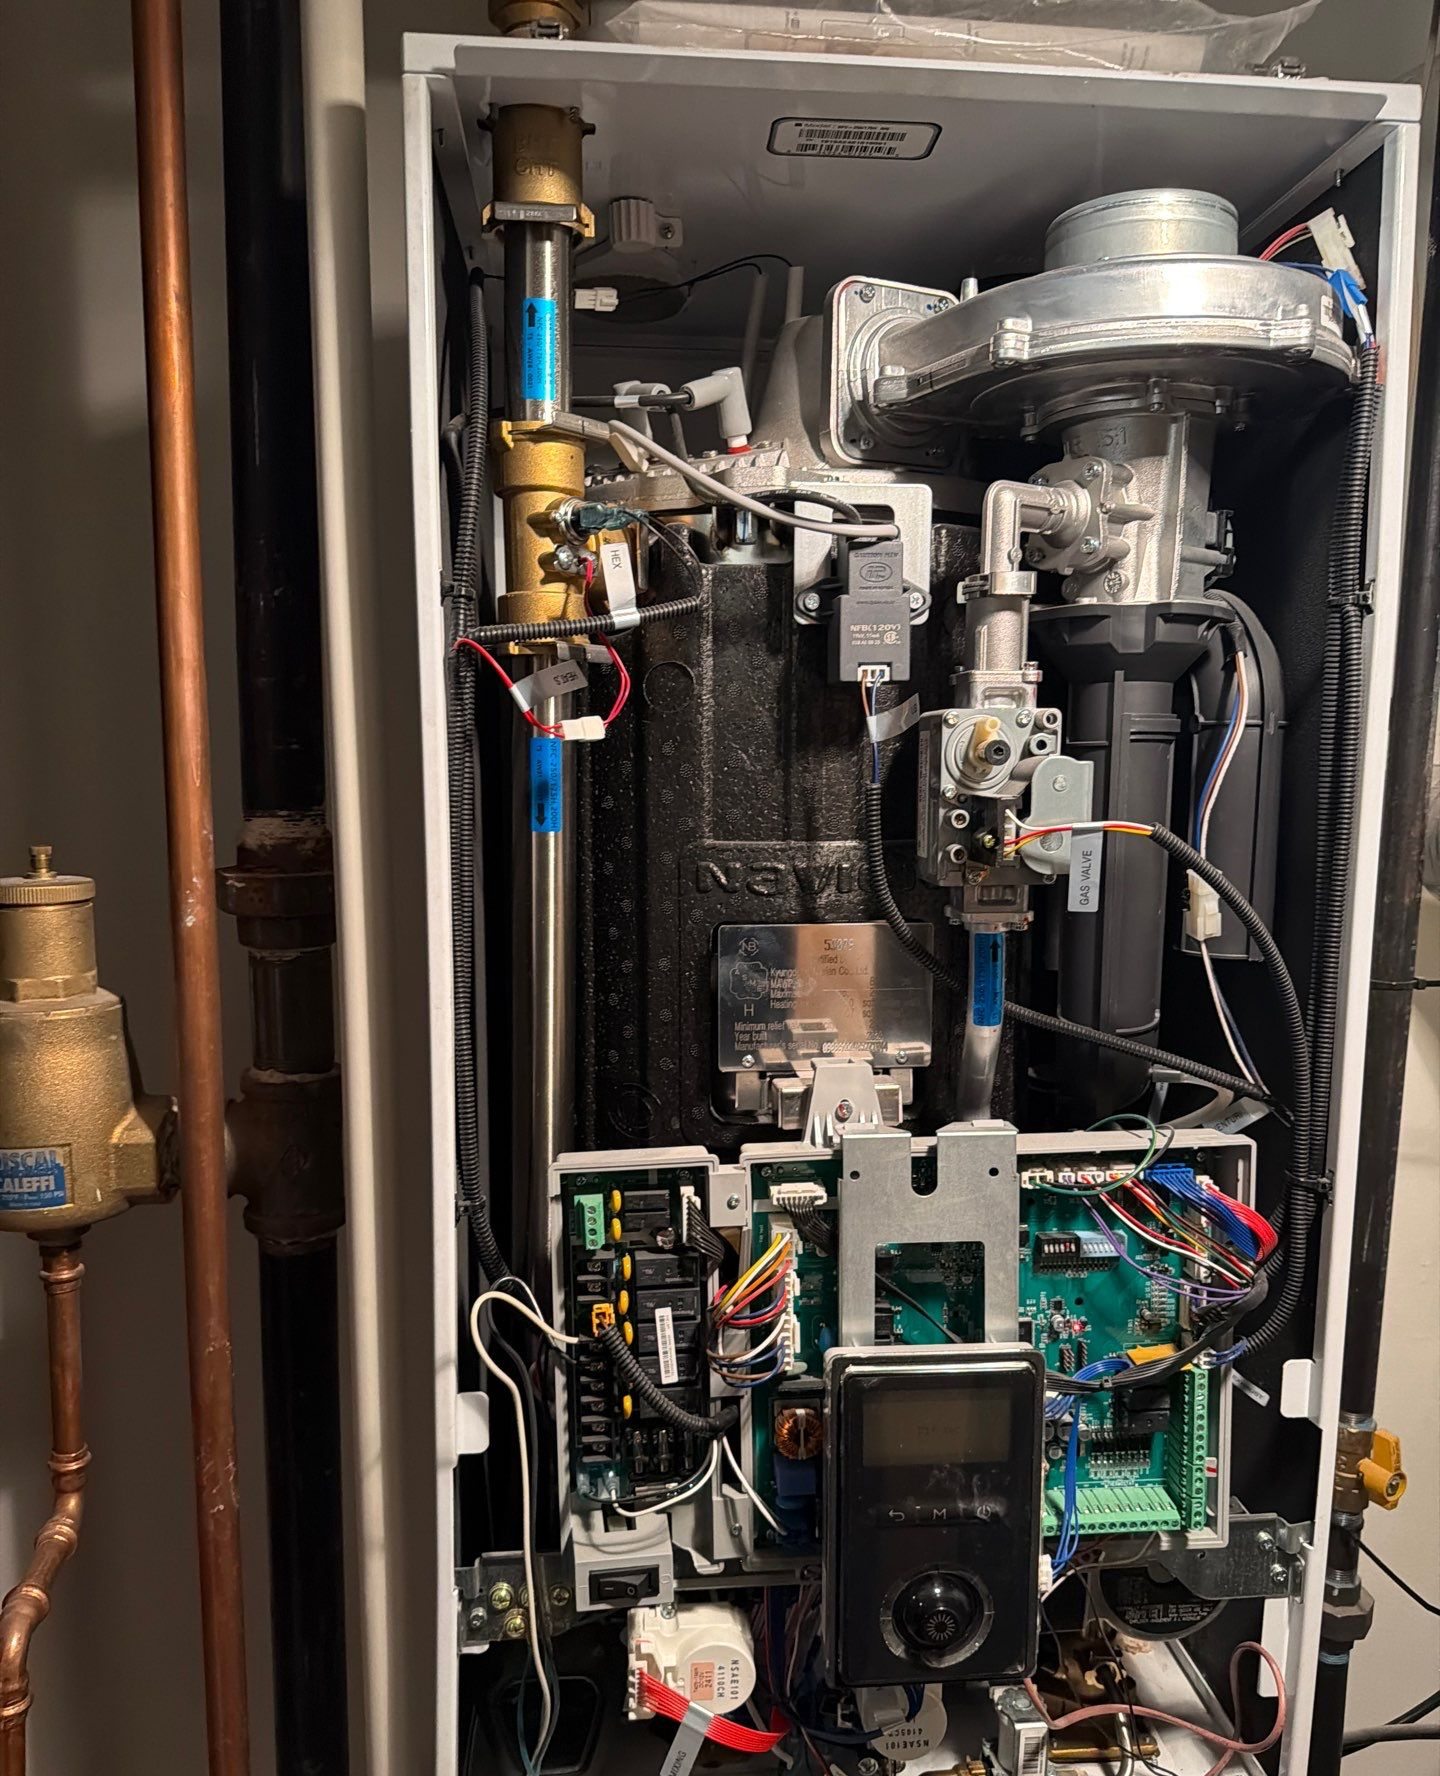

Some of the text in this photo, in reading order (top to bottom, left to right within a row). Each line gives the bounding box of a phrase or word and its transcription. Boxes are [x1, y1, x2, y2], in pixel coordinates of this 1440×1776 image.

[610, 549, 623, 570] HEX
[850, 624, 901, 632] NFB(120V)
[1079, 849, 1093, 906] GAS VALVE
[932, 1508, 947, 1521] M
[717, 1665, 726, 1698] 4110CH
[730, 1659, 740, 1700] NSAE101
[885, 1739, 929, 1750] NSAE101
